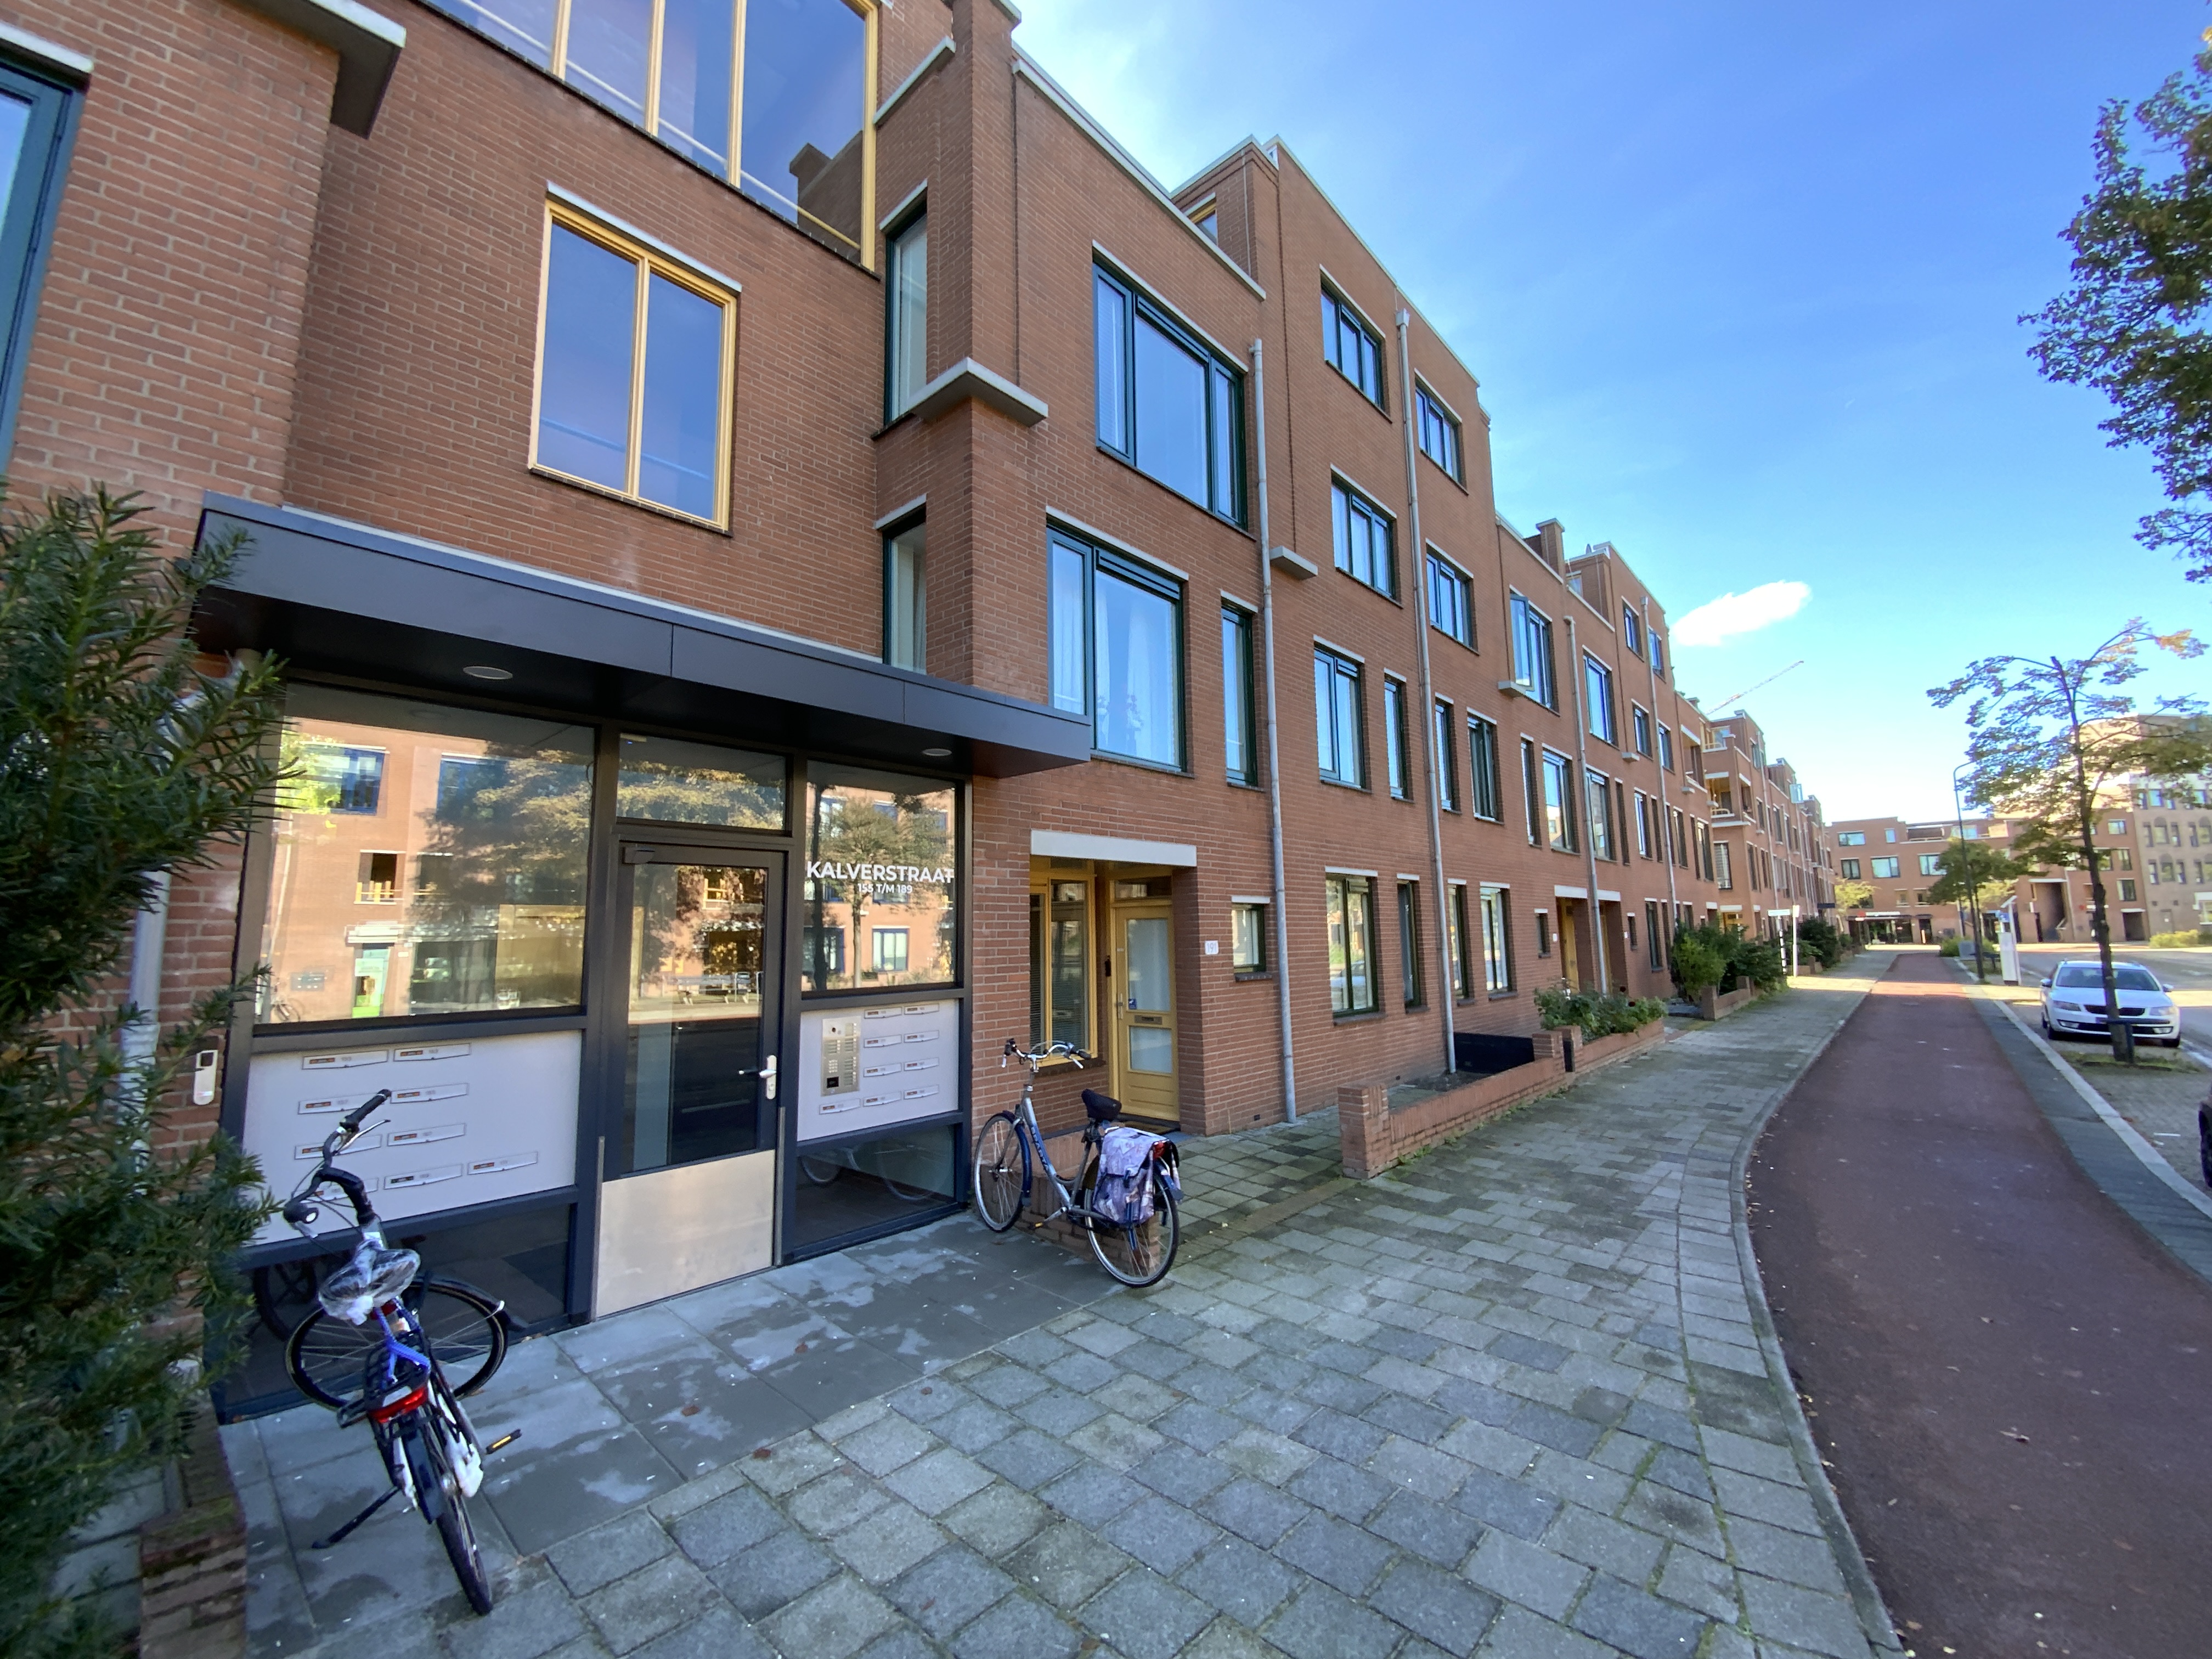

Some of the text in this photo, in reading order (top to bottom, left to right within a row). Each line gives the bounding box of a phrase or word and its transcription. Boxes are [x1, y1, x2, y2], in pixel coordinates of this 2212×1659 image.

[807, 861, 955, 883] KALVERSTRAAT
[876, 883, 895, 894] T/M
[897, 884, 913, 894] 189
[1207, 943, 1217, 953] 191
